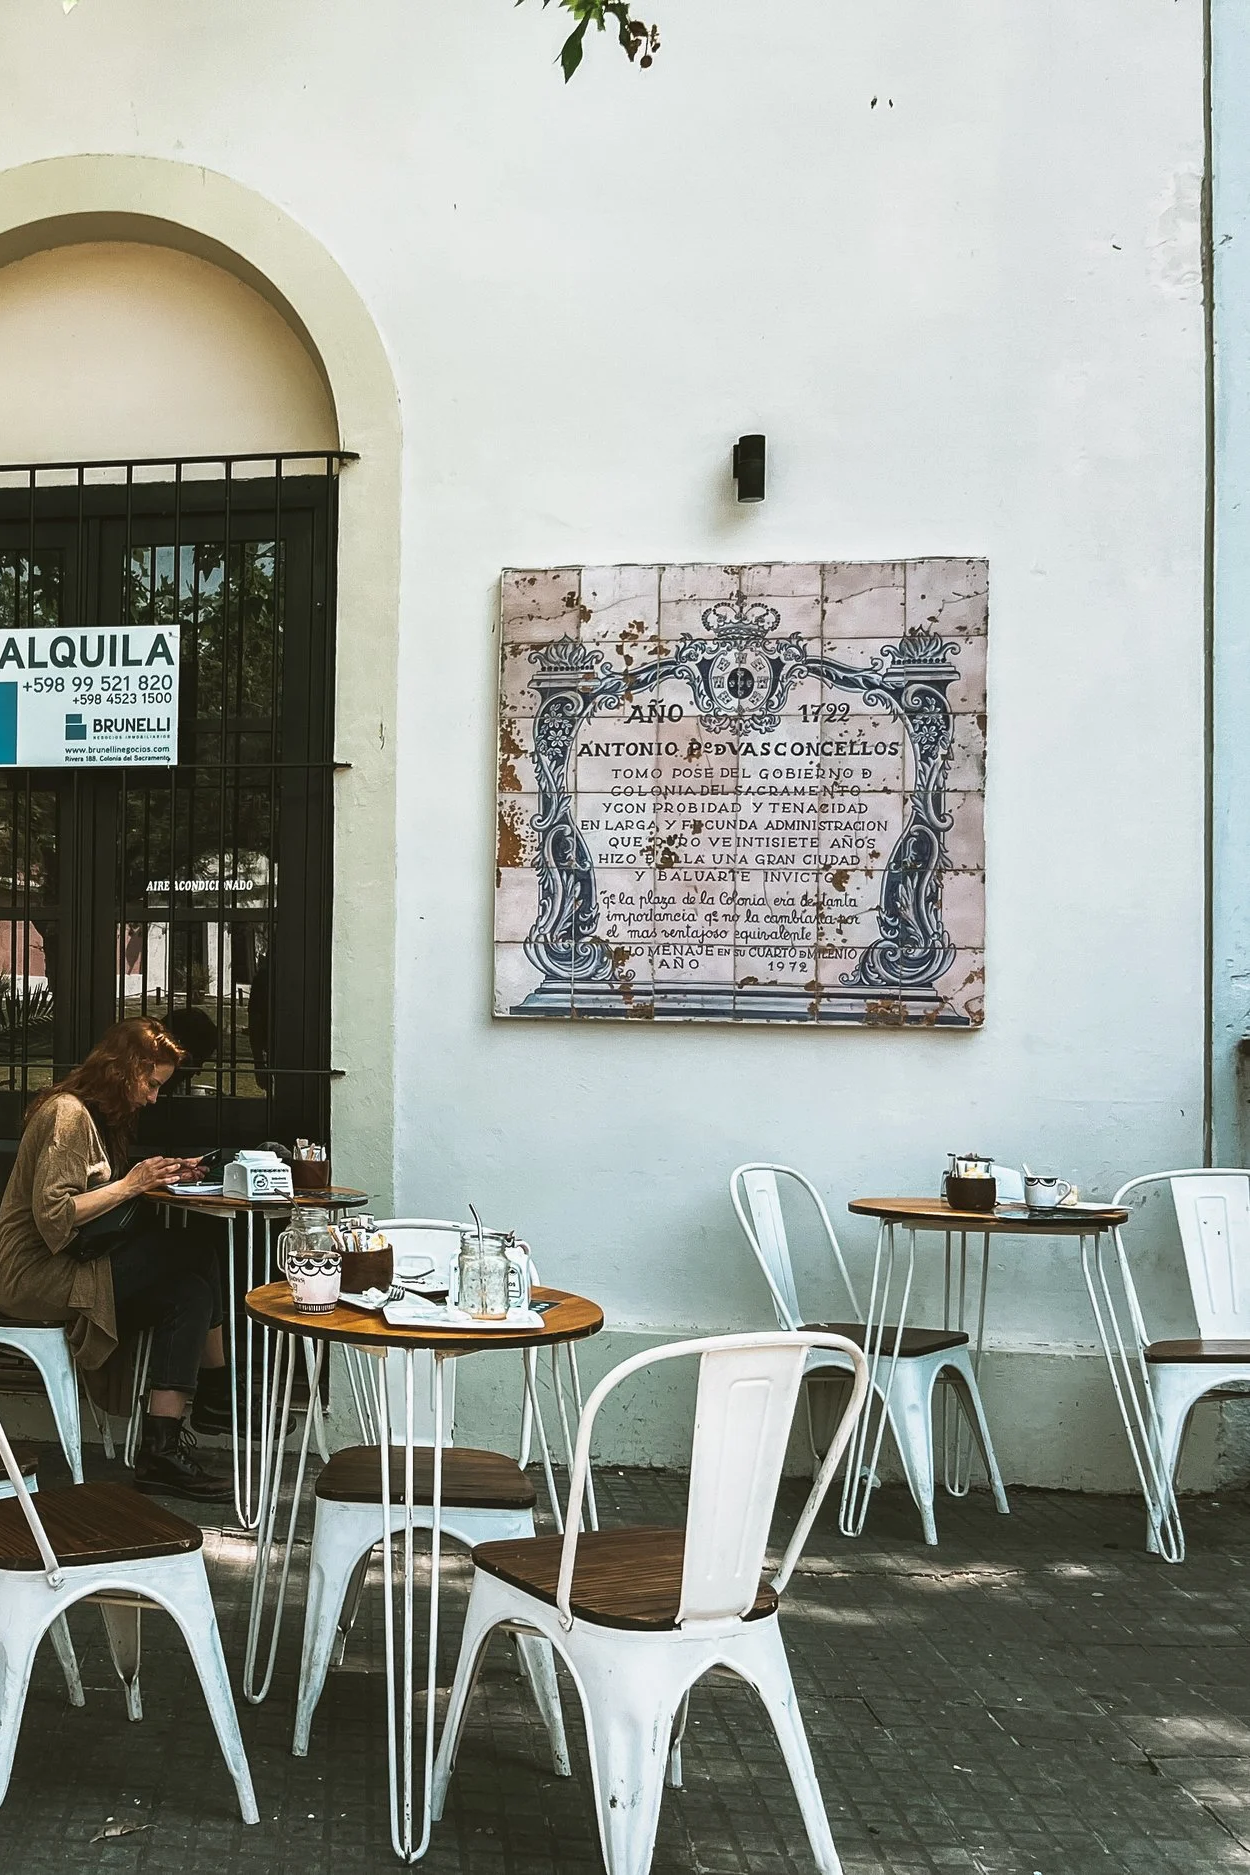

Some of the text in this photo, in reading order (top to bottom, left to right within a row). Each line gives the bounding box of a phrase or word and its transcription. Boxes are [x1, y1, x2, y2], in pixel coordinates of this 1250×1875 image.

[22, 674, 173, 693] +598 99 521 820
[72, 692, 172, 705] +598 4523 1500
[624, 698, 684, 724] AÑO
[798, 702, 850, 723] 1722
[93, 717, 171, 733] BRUNELLI
[65, 746, 170, 755] www.brunellinegocios.com
[611, 768, 662, 779] TOMO
[672, 768, 714, 779] POSE
[720, 768, 751, 779] DEL
[758, 767, 853, 780] GOBIERNO
[734, 785, 861, 797] SACRAMENTO
[653, 802, 742, 814] PROBIDAD
[752, 802, 763, 813] Y
[769, 802, 868, 814] TENACIDAD
[581, 819, 888, 832] EN LARGA Y FCUNDA ADMINISTRACION
[608, 836, 642, 848] QUE
[829, 834, 876, 849] AÑOS
[598, 853, 637, 864] HIZO
[712, 853, 748, 865] UNA
[754, 853, 795, 865] GRAN
[802, 854, 861, 866] CIUDAD
[635, 870, 835, 883] Y BALUARTE INVICTO
[145, 880, 170, 891] AIRE
[619, 891, 636, 906] la
[639, 890, 676, 909] plaza
[682, 891, 697, 905] de
[698, 890, 715, 905] la
[719, 890, 766, 906] Colonia
[821, 891, 858, 907] tanta
[606, 908, 697, 926] importancia
[722, 913, 741, 923] no
[744, 908, 760, 923] la
[606, 923, 620, 938] el
[627, 927, 658, 939] mas
[620, 945, 714, 957] HOMENAJE
[717, 947, 731, 956] EN
[734, 947, 746, 957] SU
[748, 947, 797, 958] CUARTO
[657, 956, 699, 969] AÑO
[767, 961, 808, 973] 1972
